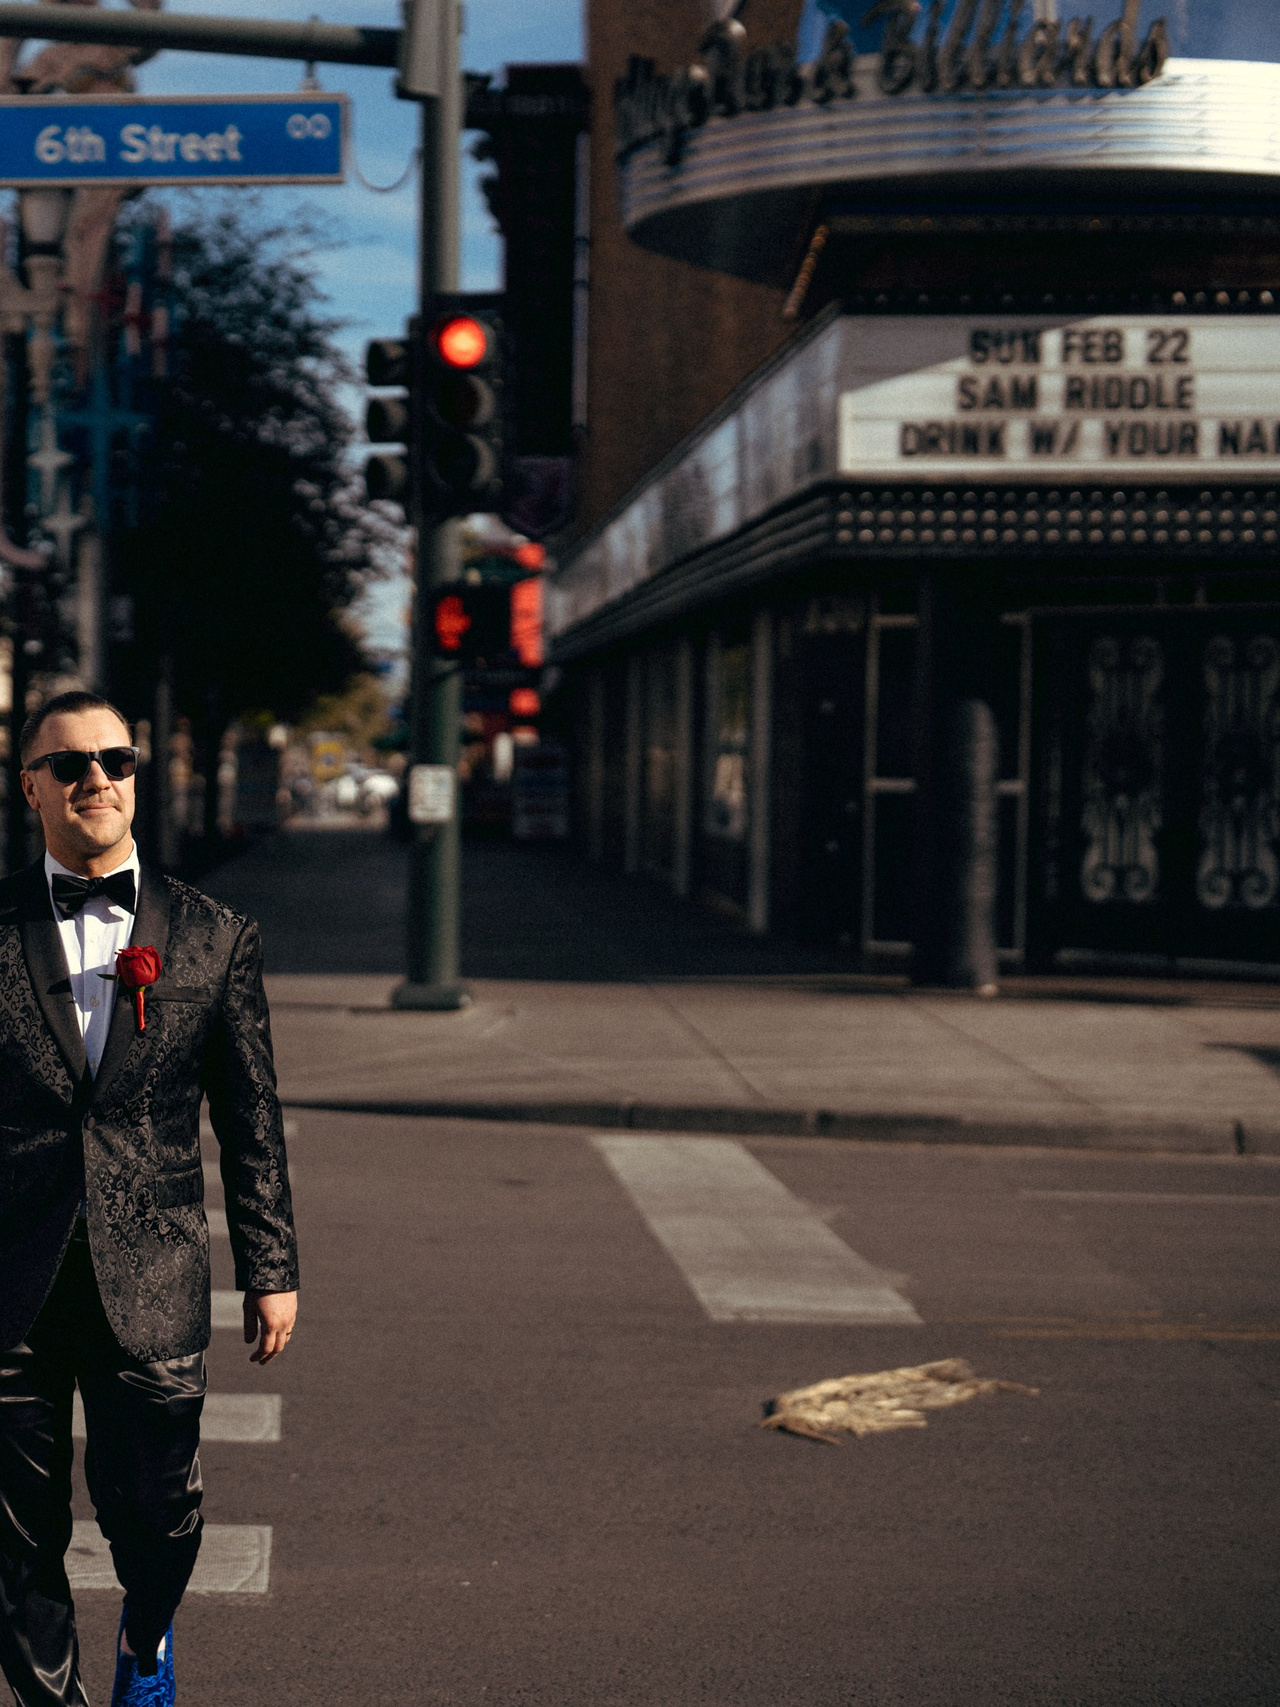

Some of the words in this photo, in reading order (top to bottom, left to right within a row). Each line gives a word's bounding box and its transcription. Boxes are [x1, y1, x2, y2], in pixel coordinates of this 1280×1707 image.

[34, 124, 107, 164] 6th
[120, 122, 244, 163] Street
[969, 328, 1042, 364] SUN
[1062, 329, 1124, 364] FEB
[1145, 329, 1190, 364] 22
[956, 374, 1038, 410] SAM
[1063, 374, 1194, 411] RIDDLE
[900, 420, 1007, 456] DRINK
[1028, 420, 1081, 456] W/
[1103, 420, 1199, 456] YOUR
